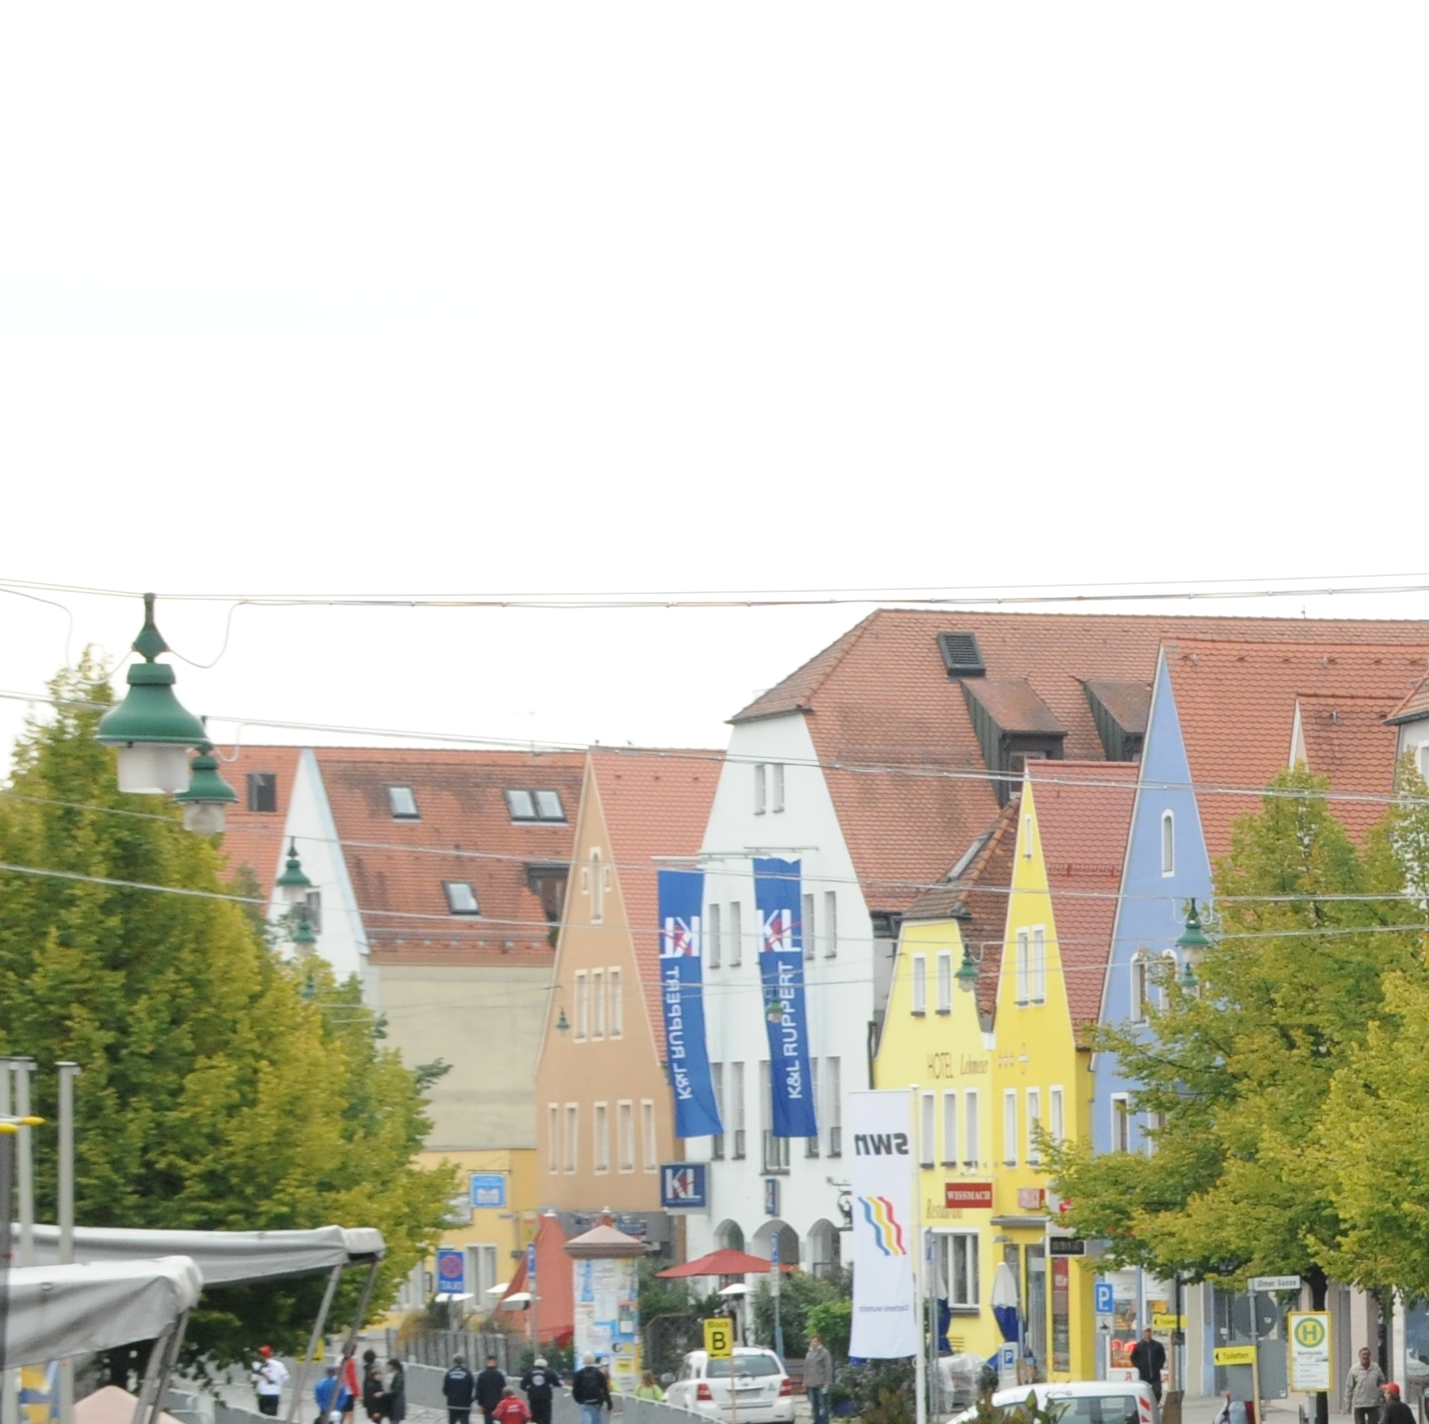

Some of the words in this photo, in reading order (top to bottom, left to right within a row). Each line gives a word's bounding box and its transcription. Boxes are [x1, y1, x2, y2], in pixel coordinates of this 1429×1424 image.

[778, 961, 800, 1057] RUPPERT
[784, 1060, 803, 1099] K&L
[926, 1052, 954, 1079] HOTEL
[665, 1168, 702, 1200] KL
[711, 1331, 727, 1351] B
